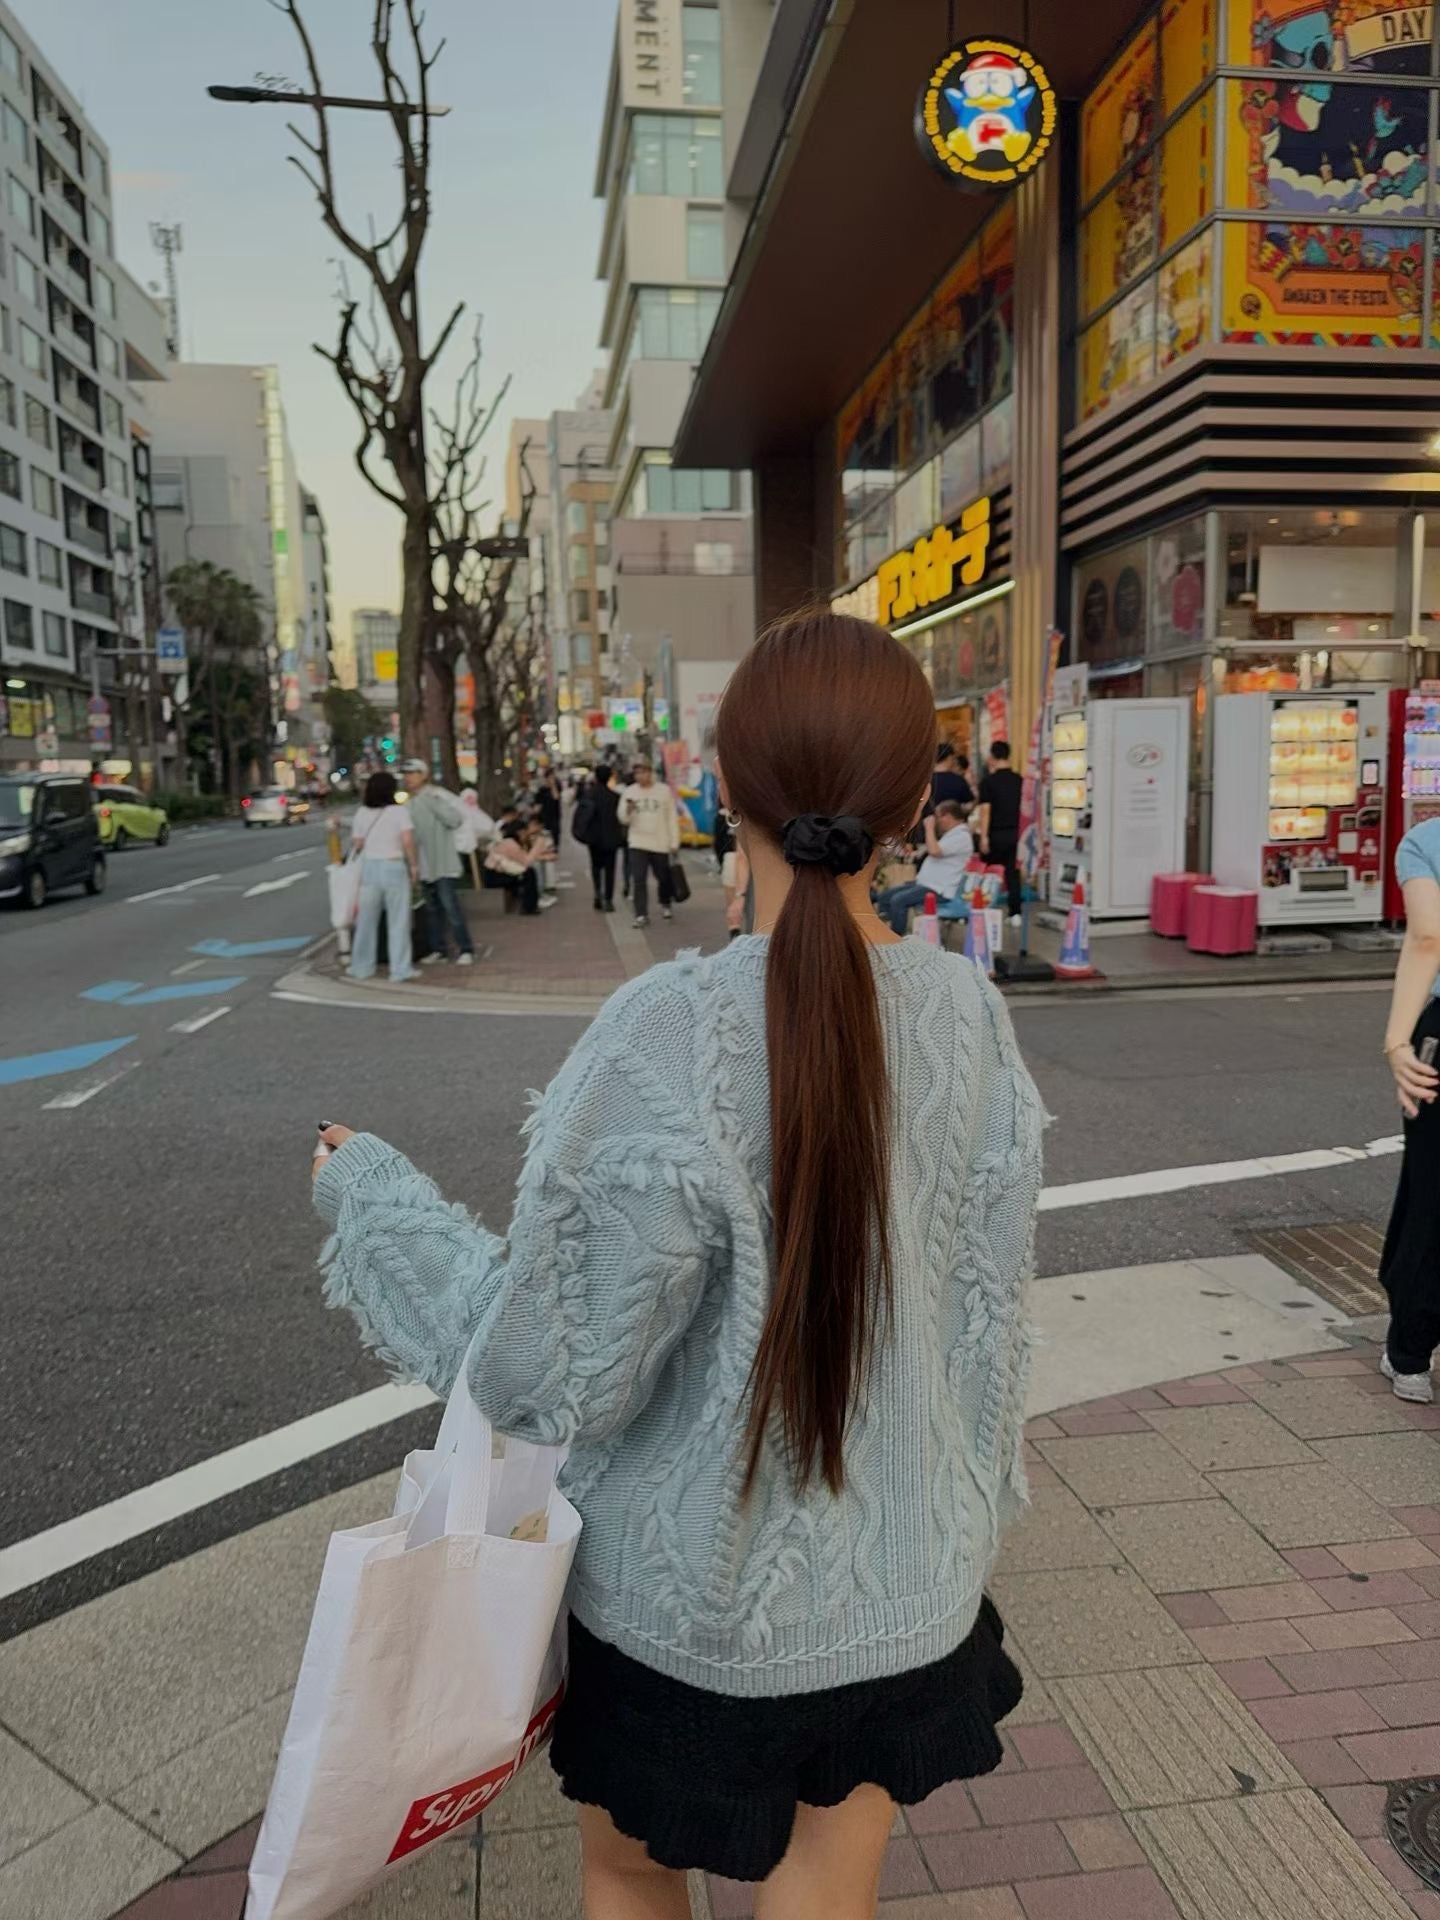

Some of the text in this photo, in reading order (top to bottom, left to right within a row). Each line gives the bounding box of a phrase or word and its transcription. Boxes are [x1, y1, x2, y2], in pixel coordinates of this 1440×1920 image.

[1382, 9, 1426, 42] DAY
[1283, 288, 1389, 306] AWAKEN THE FIESTA
